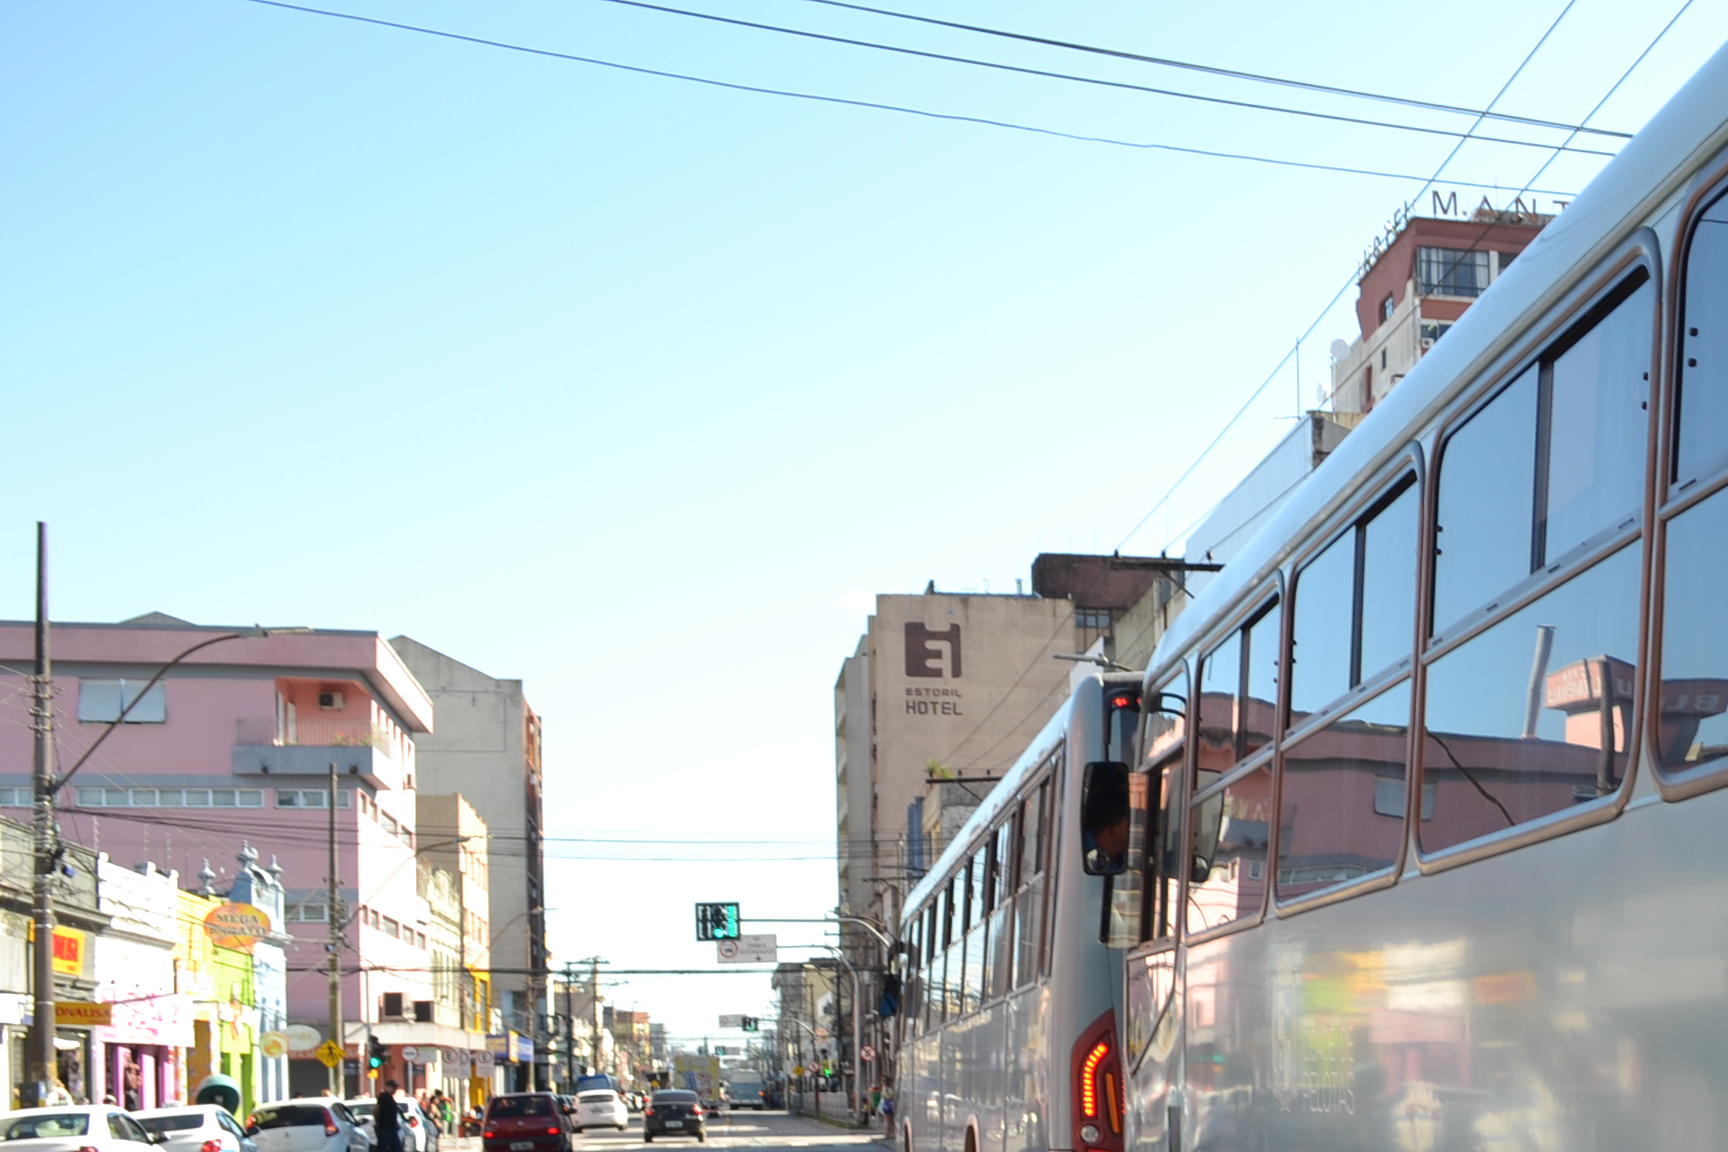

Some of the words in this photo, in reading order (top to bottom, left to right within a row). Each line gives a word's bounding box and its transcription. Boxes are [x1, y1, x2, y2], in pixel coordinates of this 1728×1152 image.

[904, 687, 962, 698] ESTORIL
[905, 700, 964, 716] HOTEL
[216, 913, 260, 924] MEGA
[56, 1006, 112, 1018] ONALISA
[1302, 1071, 1356, 1116] PELOTAS
